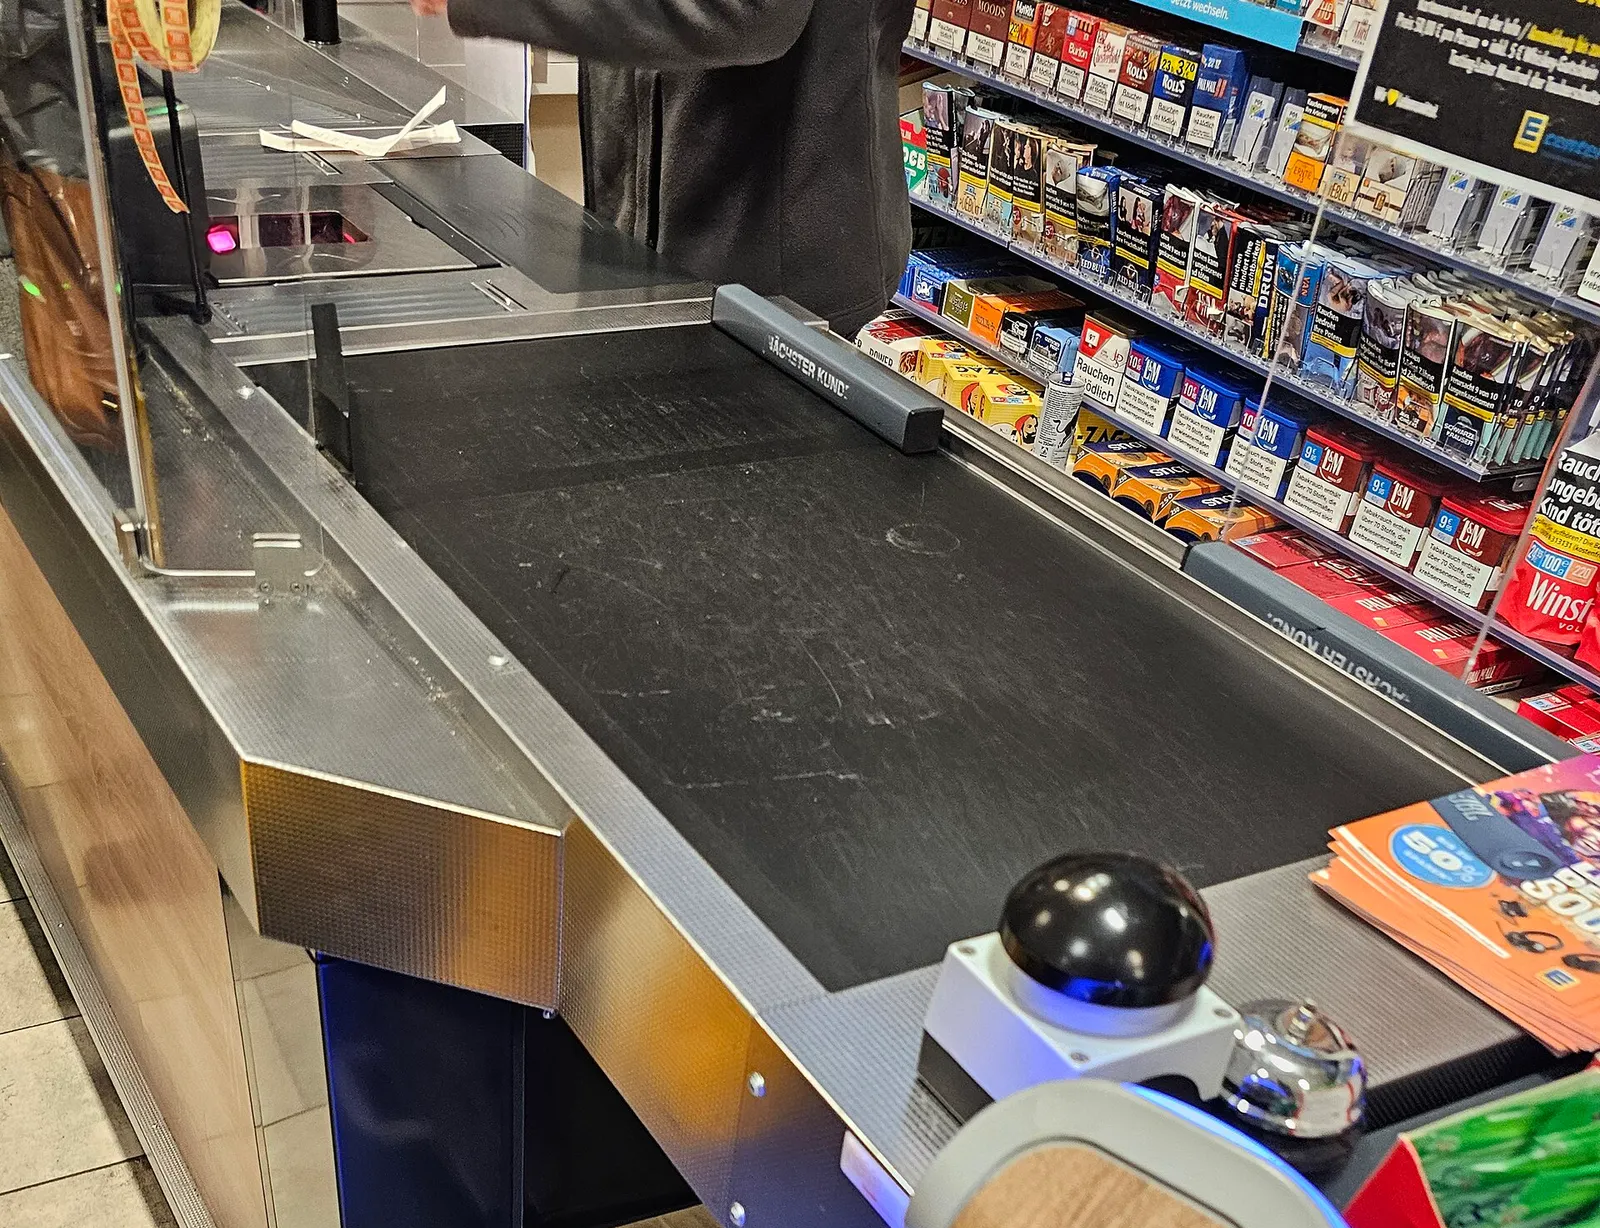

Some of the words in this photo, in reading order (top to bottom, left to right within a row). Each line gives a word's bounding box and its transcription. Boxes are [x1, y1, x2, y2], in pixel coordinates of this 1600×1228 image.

[1192, 2, 1230, 20] wechseln.
[1231, 253, 1243, 287] Rauchen
[1239, 261, 1249, 291] mindert
[1259, 254, 1276, 308] DRUM
[1077, 357, 1115, 387] Rauchen
[1144, 357, 1161, 384] L&M
[1199, 385, 1218, 413] L&M
[1490, 392, 1499, 401] 10
[1258, 415, 1279, 444] L&M
[1321, 447, 1345, 476] L&M
[1160, 493, 1173, 508] 250
[1391, 481, 1415, 511] L&M
[1537, 497, 1572, 525] Kind
[1459, 518, 1487, 549] L&M
[1429, 542, 1461, 563] Tabakrauch
[1461, 560, 1481, 574] enthält
[1448, 563, 1465, 578] Stoffe,
[1541, 553, 1560, 573] 100
[1418, 568, 1460, 593] krebserregend
[1460, 586, 1471, 600] sind.
[1424, 561, 1472, 589] erwiesenermaßen
[1526, 571, 1596, 623] Winst
[1558, 622, 1581, 633] VOL
[1402, 831, 1486, 884] 50%
